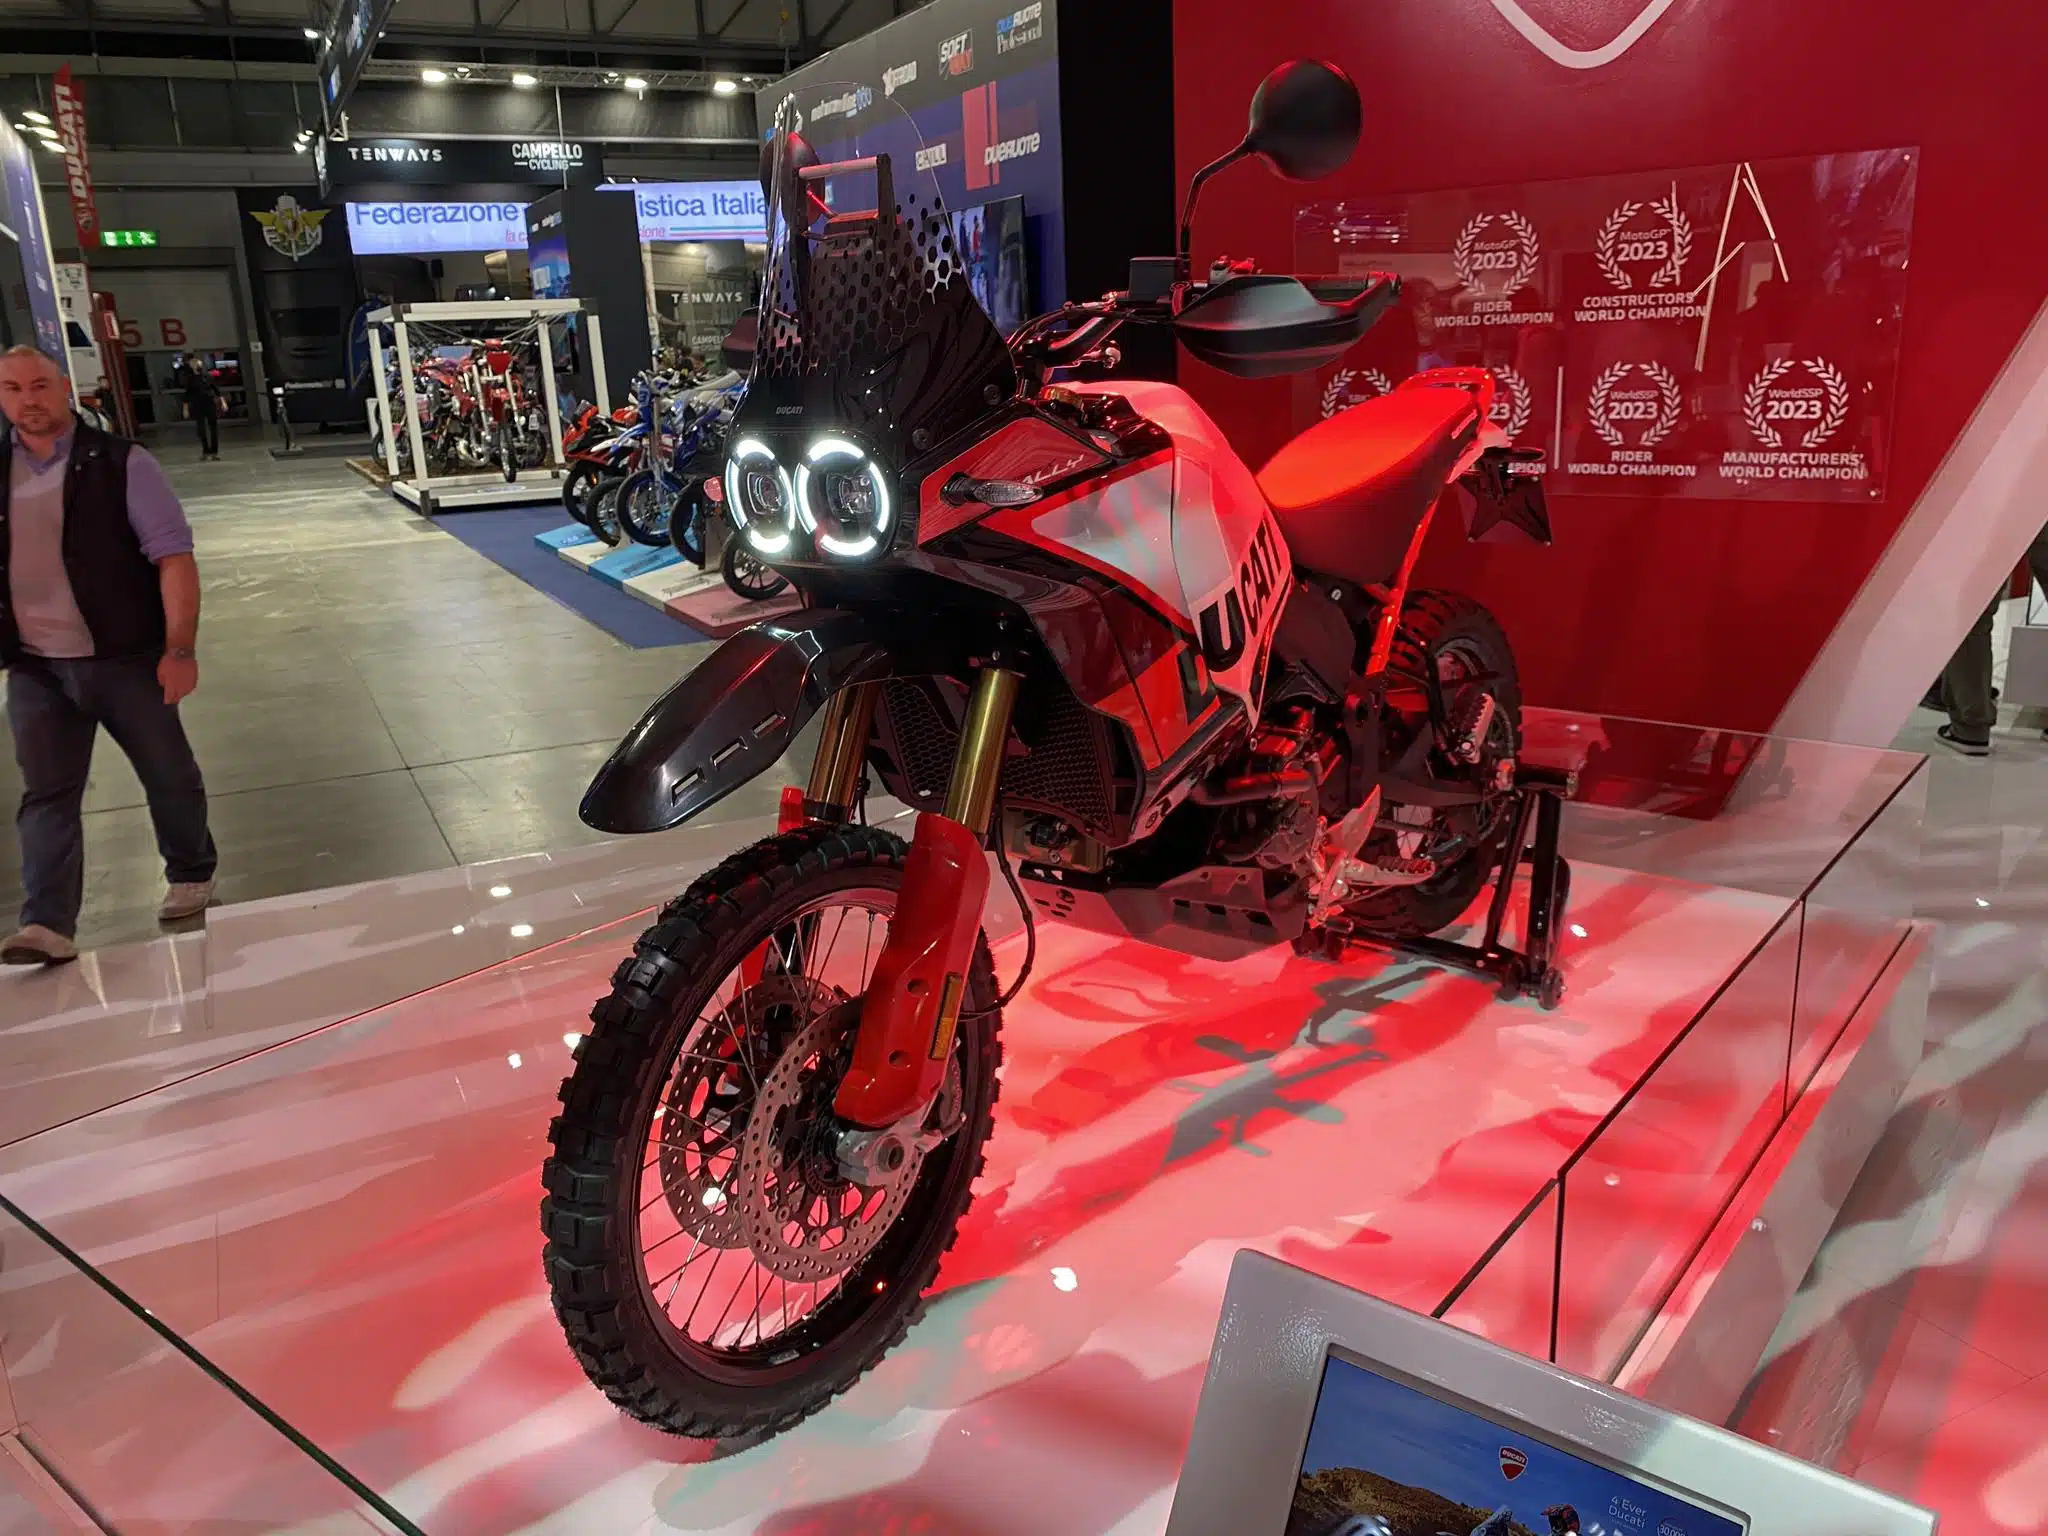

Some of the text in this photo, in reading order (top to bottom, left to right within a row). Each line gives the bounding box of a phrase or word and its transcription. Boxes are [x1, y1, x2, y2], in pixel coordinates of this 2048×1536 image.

[55, 83, 89, 198] DUCATI
[348, 147, 443, 163] TENWAYS
[511, 143, 584, 161] CAMPELLO
[528, 159, 570, 171] CYCLING
[355, 203, 519, 225] Federazione
[637, 193, 707, 218] istica
[1616, 240, 1669, 262] 2023
[1471, 250, 1519, 271] 2023
[671, 291, 744, 304] TENWAYS
[1472, 300, 1513, 313] RIDER
[1433, 311, 1555, 328] WORLD CHAMPION
[1574, 305, 1708, 322] WORLD CHAMPION
[159, 317, 188, 347] B
[775, 406, 805, 415] DUCATI
[1607, 401, 1659, 420] 2023
[1764, 399, 1823, 420] 2023
[1610, 450, 1654, 462] RIDER
[1567, 463, 1698, 477] WORLD CHAMPION
[1719, 466, 1866, 481] WORLD CHAMPION
[1176, 517, 1283, 727] DUCATI
[1502, 1450, 1527, 1464] DUCATI
[1611, 1496, 1648, 1517] 4 Ever
[1608, 1504, 1647, 1529] Ducati
